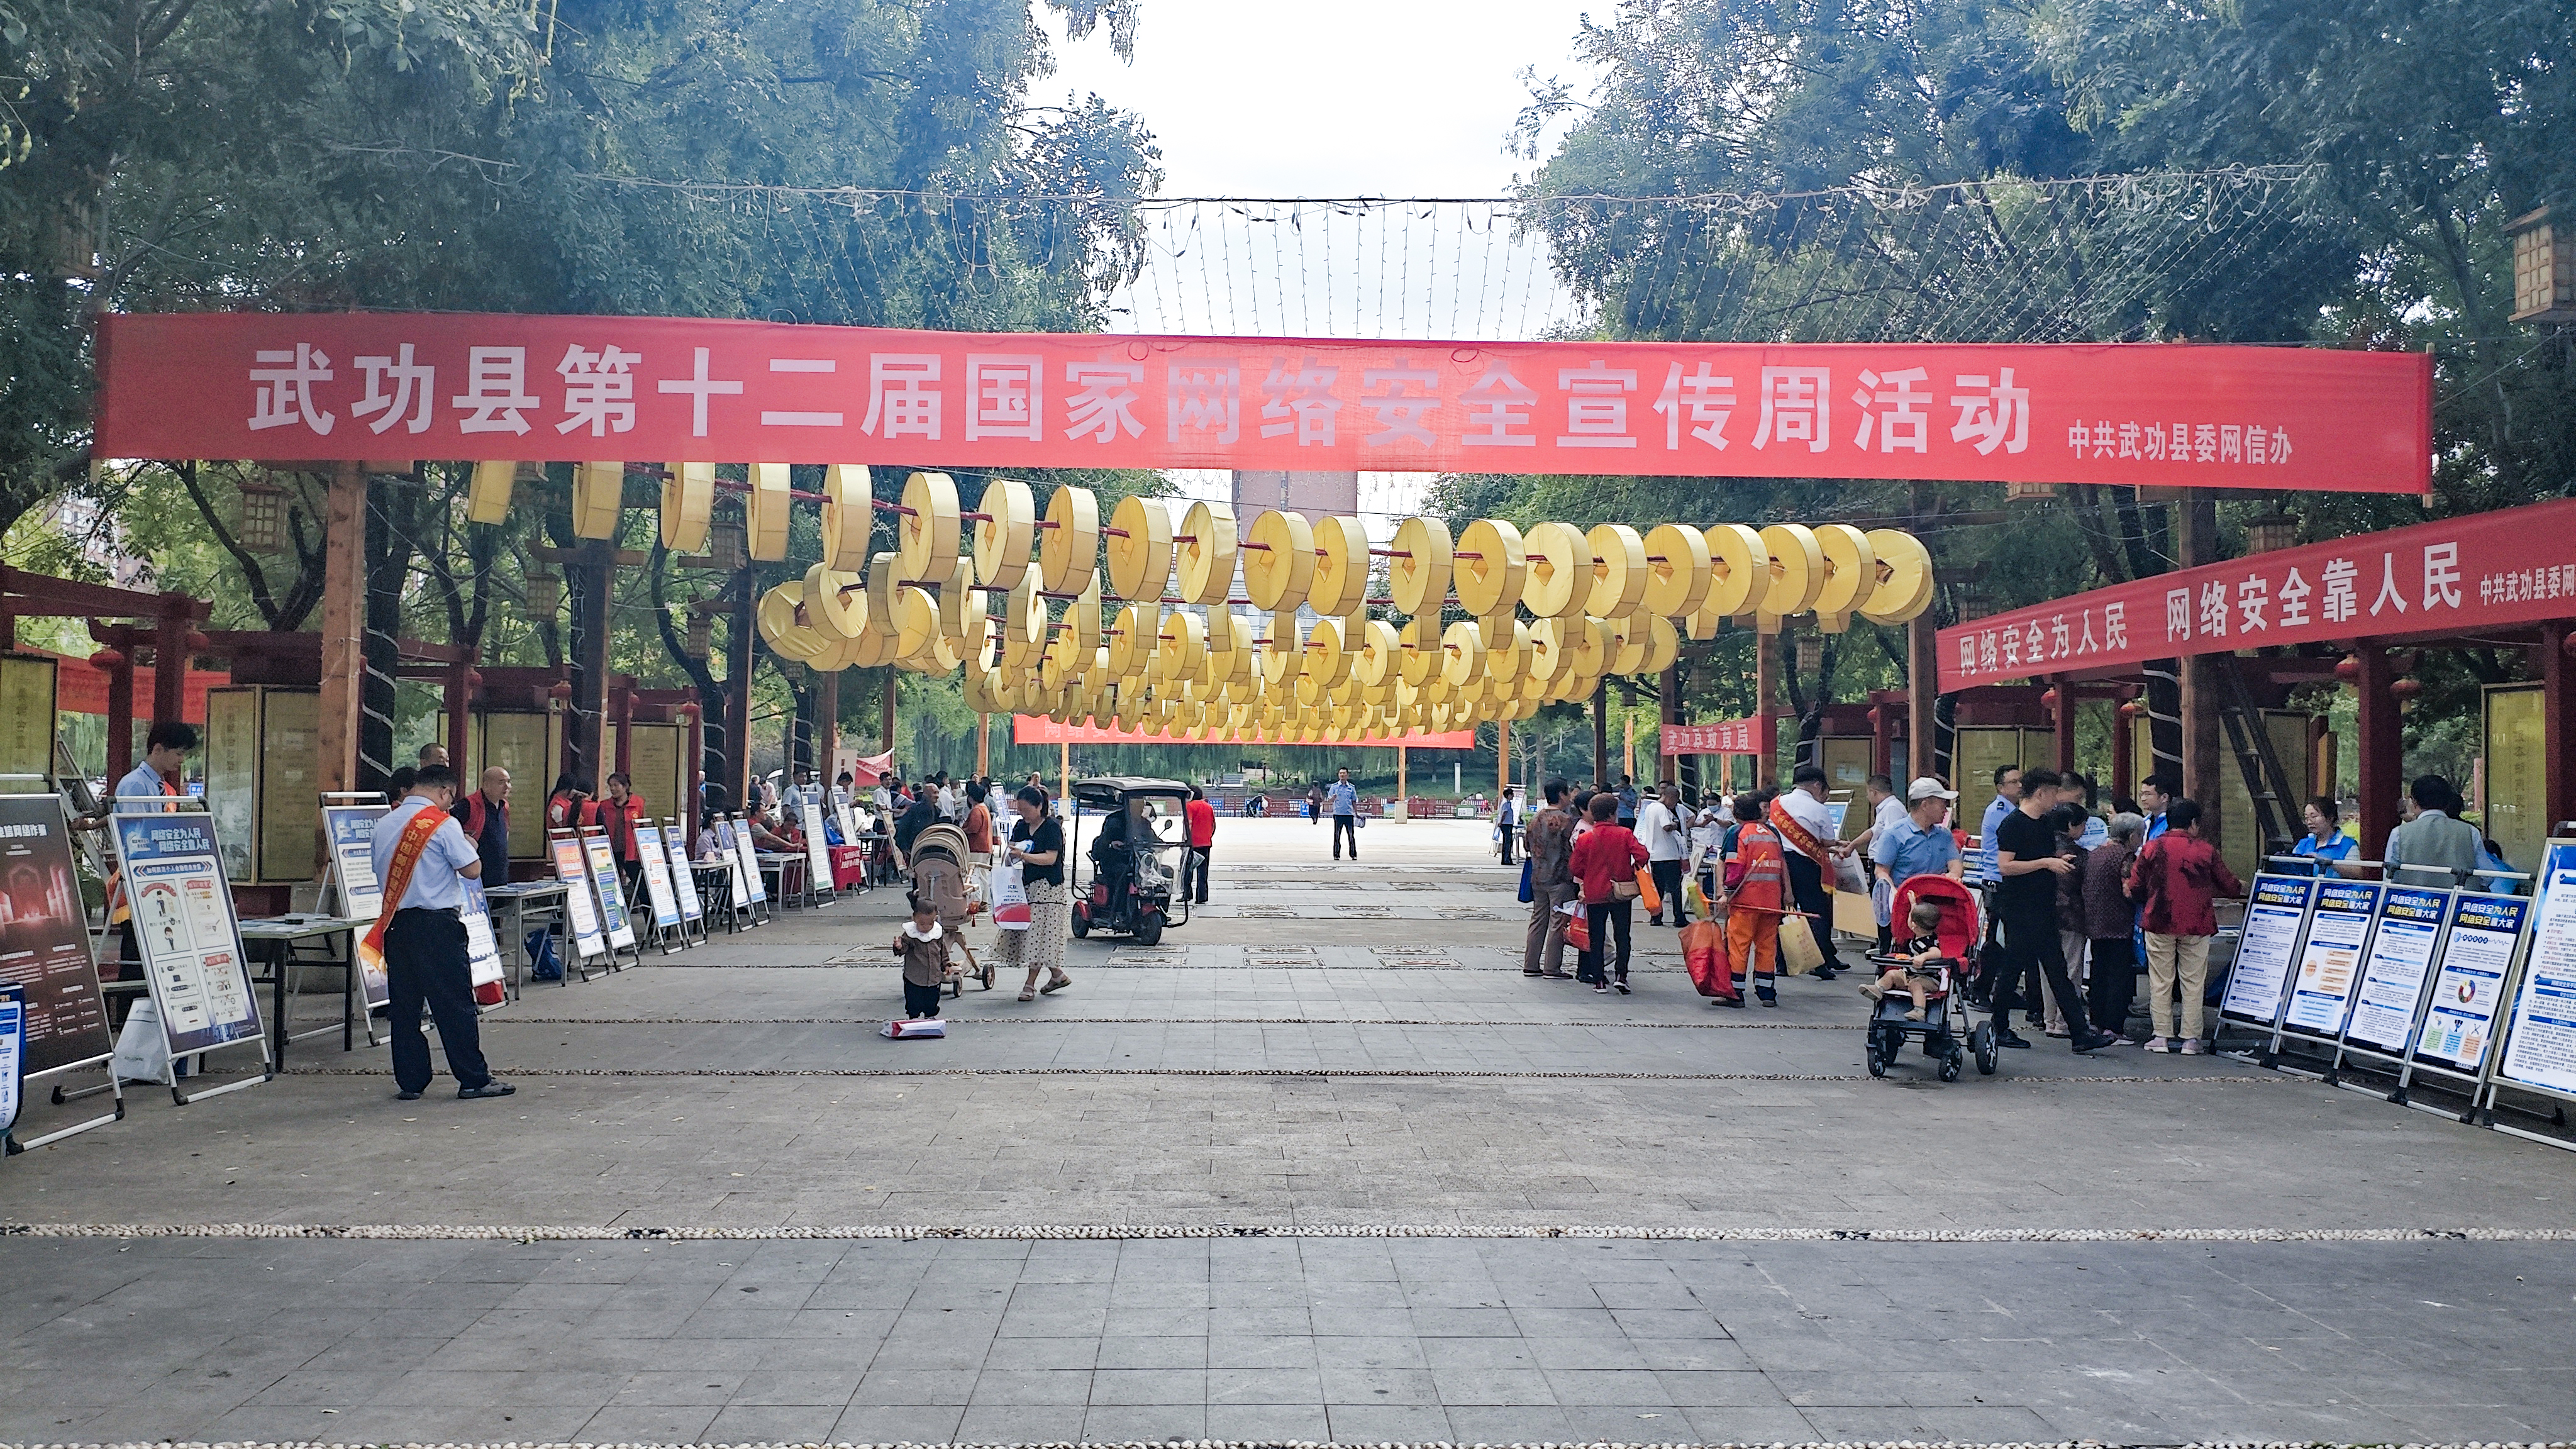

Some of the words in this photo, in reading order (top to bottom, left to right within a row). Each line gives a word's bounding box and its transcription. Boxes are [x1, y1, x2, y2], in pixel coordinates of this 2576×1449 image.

[247, 341, 2032, 455] 武功县第十二届国家网络安全宣传周活动
[2068, 418, 2294, 467] 中共武功县委网信办
[1959, 601, 2128, 677] 网络安全为人民
[2166, 541, 2462, 641] 网络安全靠人民
[1667, 723, 1748, 751] 武功县教育局
[151, 827, 202, 841] 网络安全为人民
[2260, 882, 2306, 895] 网络安全为人民
[2323, 888, 2373, 900] 网络安全为人民
[2389, 894, 2441, 908] 网络安全为人民
[2462, 902, 2519, 918] 网络安全为人民
